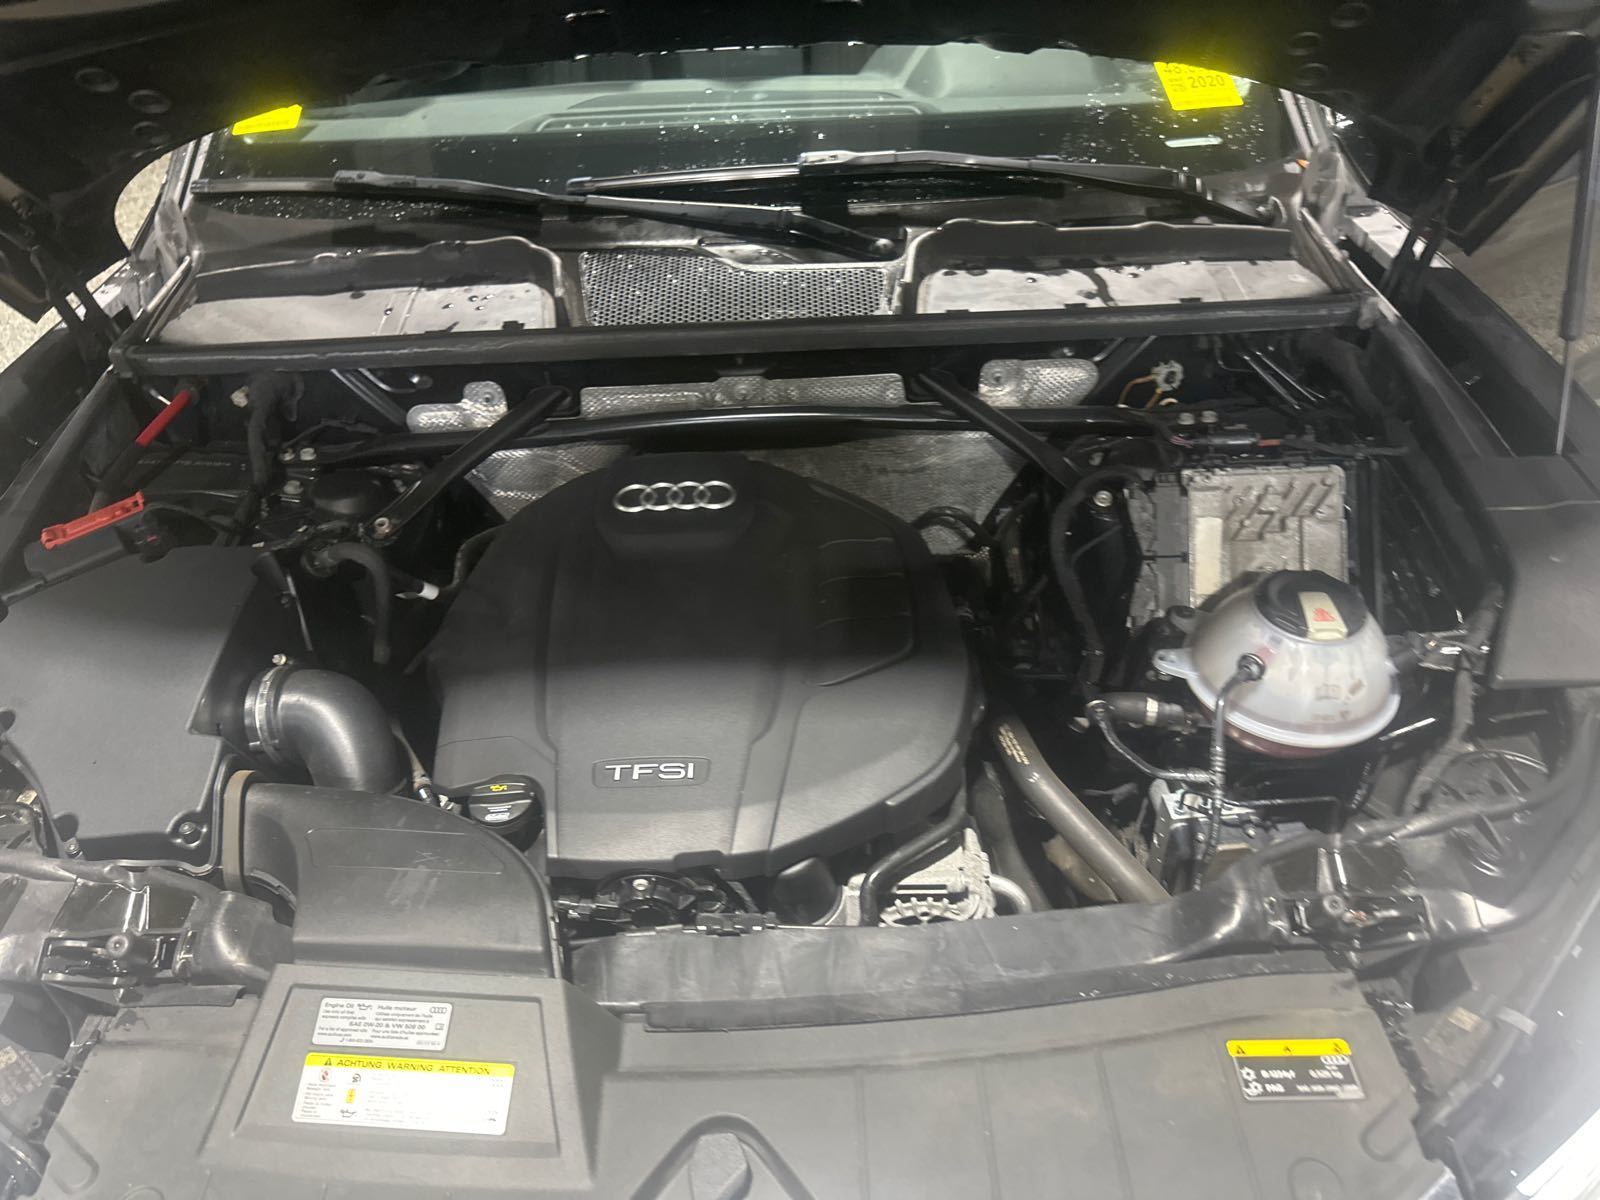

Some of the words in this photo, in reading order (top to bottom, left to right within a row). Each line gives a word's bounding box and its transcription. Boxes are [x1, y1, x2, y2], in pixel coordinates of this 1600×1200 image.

[1187, 74, 1225, 89] 2020
[605, 762, 695, 781] TFSI
[336, 1058, 382, 1069] ACHTUNG
[387, 1062, 433, 1073] WARNING
[438, 1065, 491, 1076] ATTENTION
